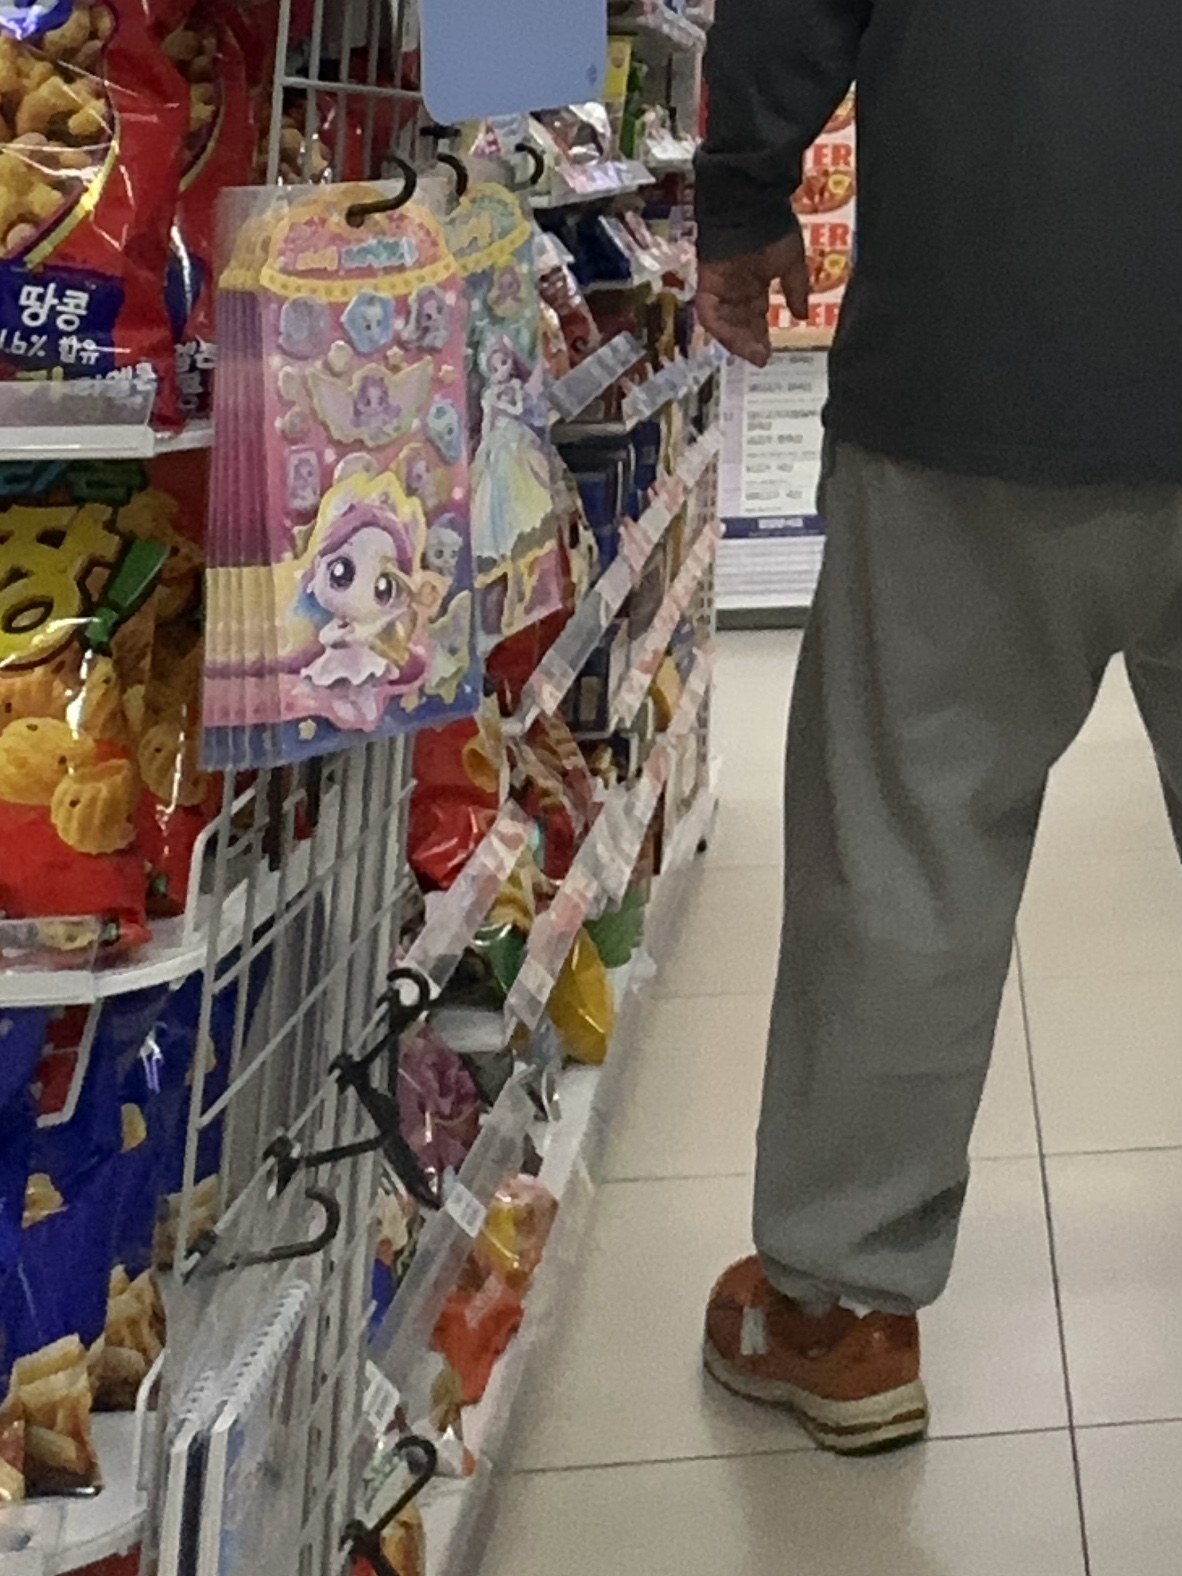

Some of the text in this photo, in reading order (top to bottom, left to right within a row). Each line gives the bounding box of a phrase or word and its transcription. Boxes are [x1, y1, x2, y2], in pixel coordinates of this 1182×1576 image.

[812, 143, 852, 167] ER
[809, 223, 850, 248] ER
[19, 283, 91, 333] 땅콩
